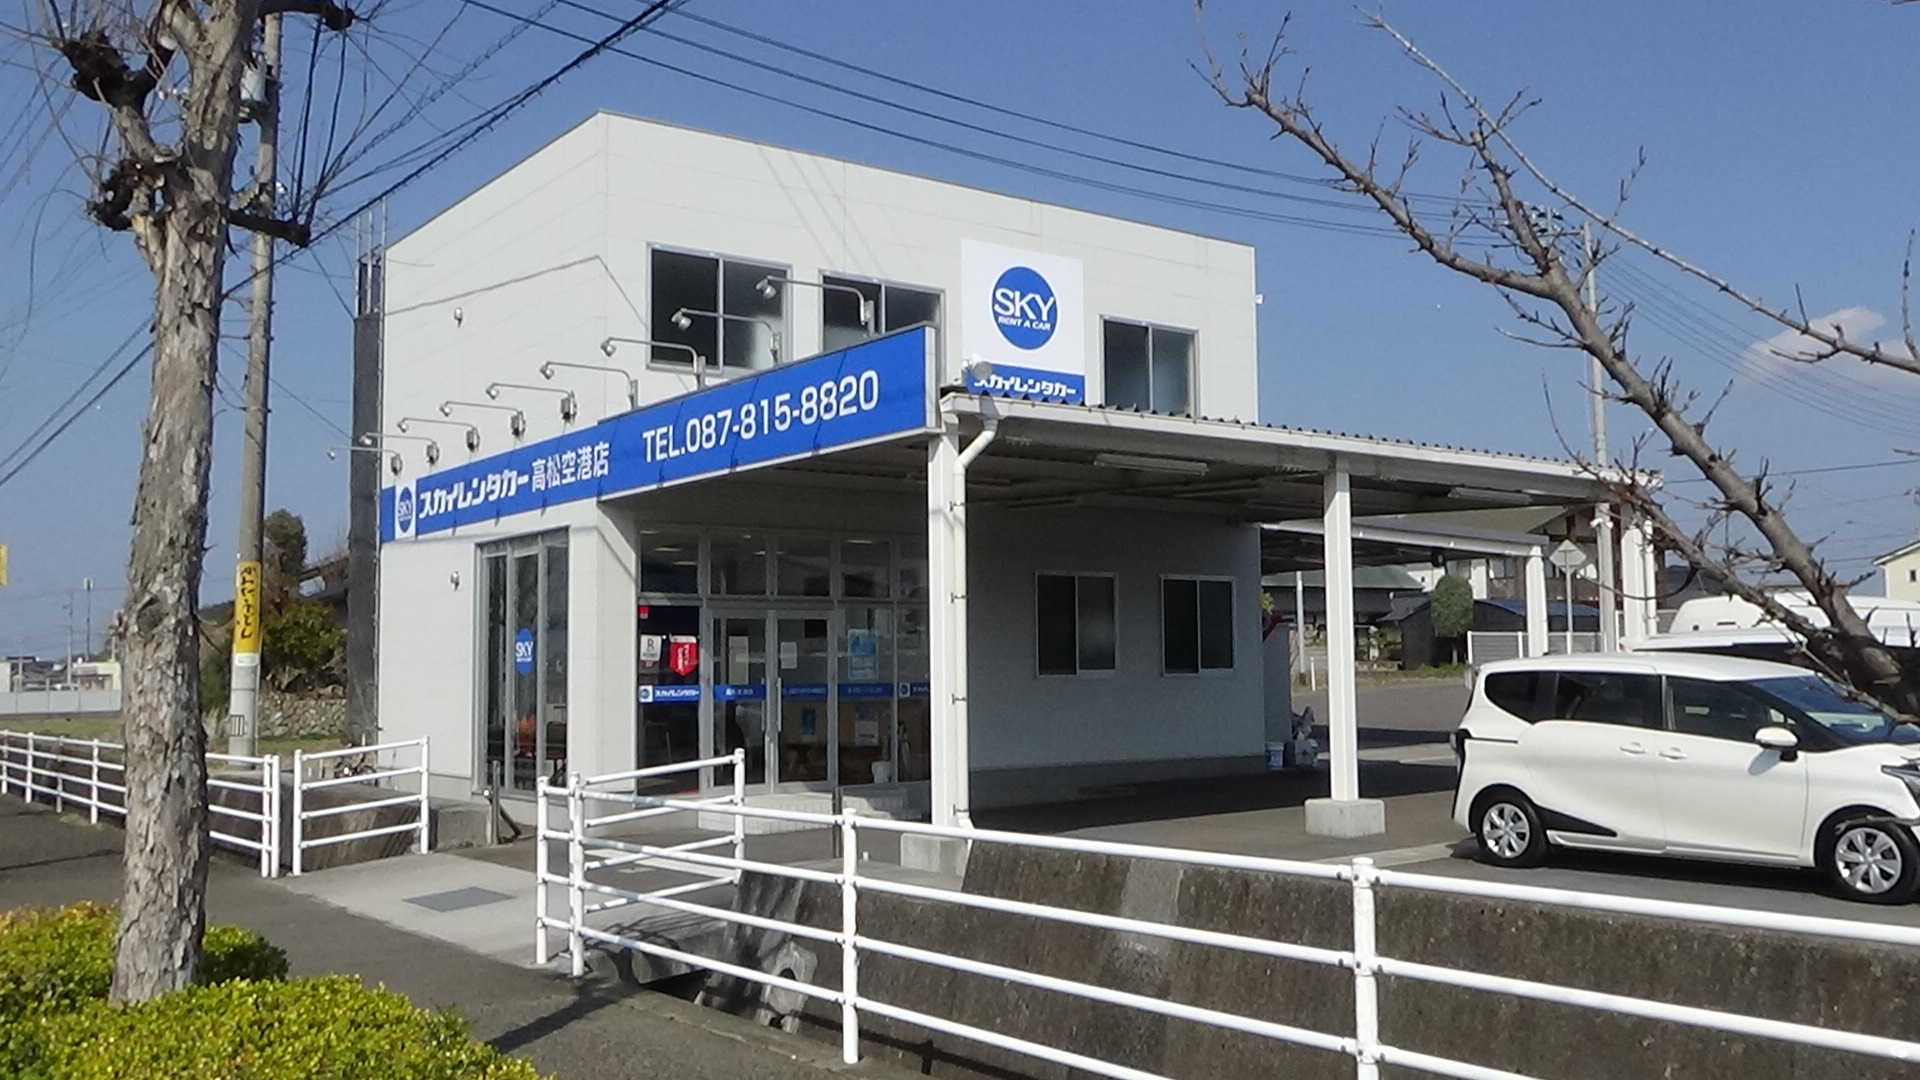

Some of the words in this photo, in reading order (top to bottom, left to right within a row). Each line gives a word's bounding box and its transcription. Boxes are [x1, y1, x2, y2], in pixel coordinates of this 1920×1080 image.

[994, 287, 1055, 321] SKY
[998, 316, 1022, 328] RENT
[1023, 321, 1031, 329] A
[1032, 321, 1051, 332] CAR
[642, 370, 879, 463] TEL.087-815-8820
[418, 469, 529, 519] スカイレンタカー
[531, 441, 610, 493] 高松空港店
[515, 641, 534, 657] SKY
